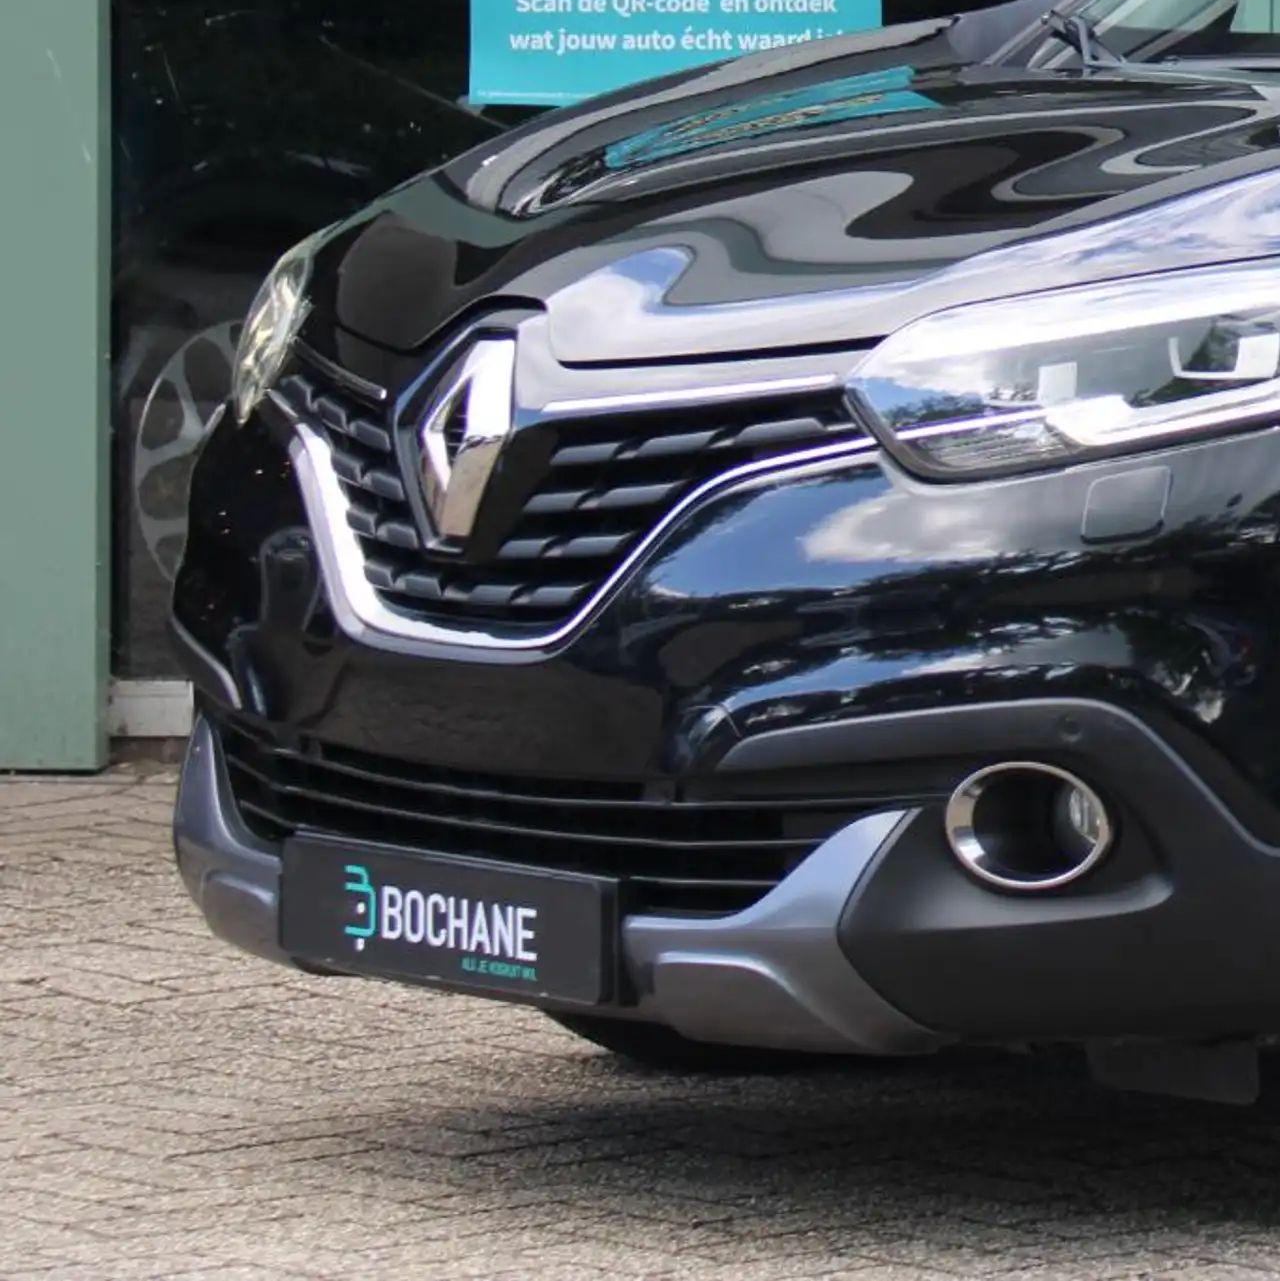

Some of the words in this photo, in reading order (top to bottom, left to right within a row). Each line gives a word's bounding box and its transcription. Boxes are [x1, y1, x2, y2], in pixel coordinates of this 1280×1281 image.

[510, 31, 554, 50] wat
[556, 28, 617, 56] jouw
[622, 30, 676, 50] auto
[681, 26, 733, 50] écht
[381, 885, 538, 962] BOCHANE
